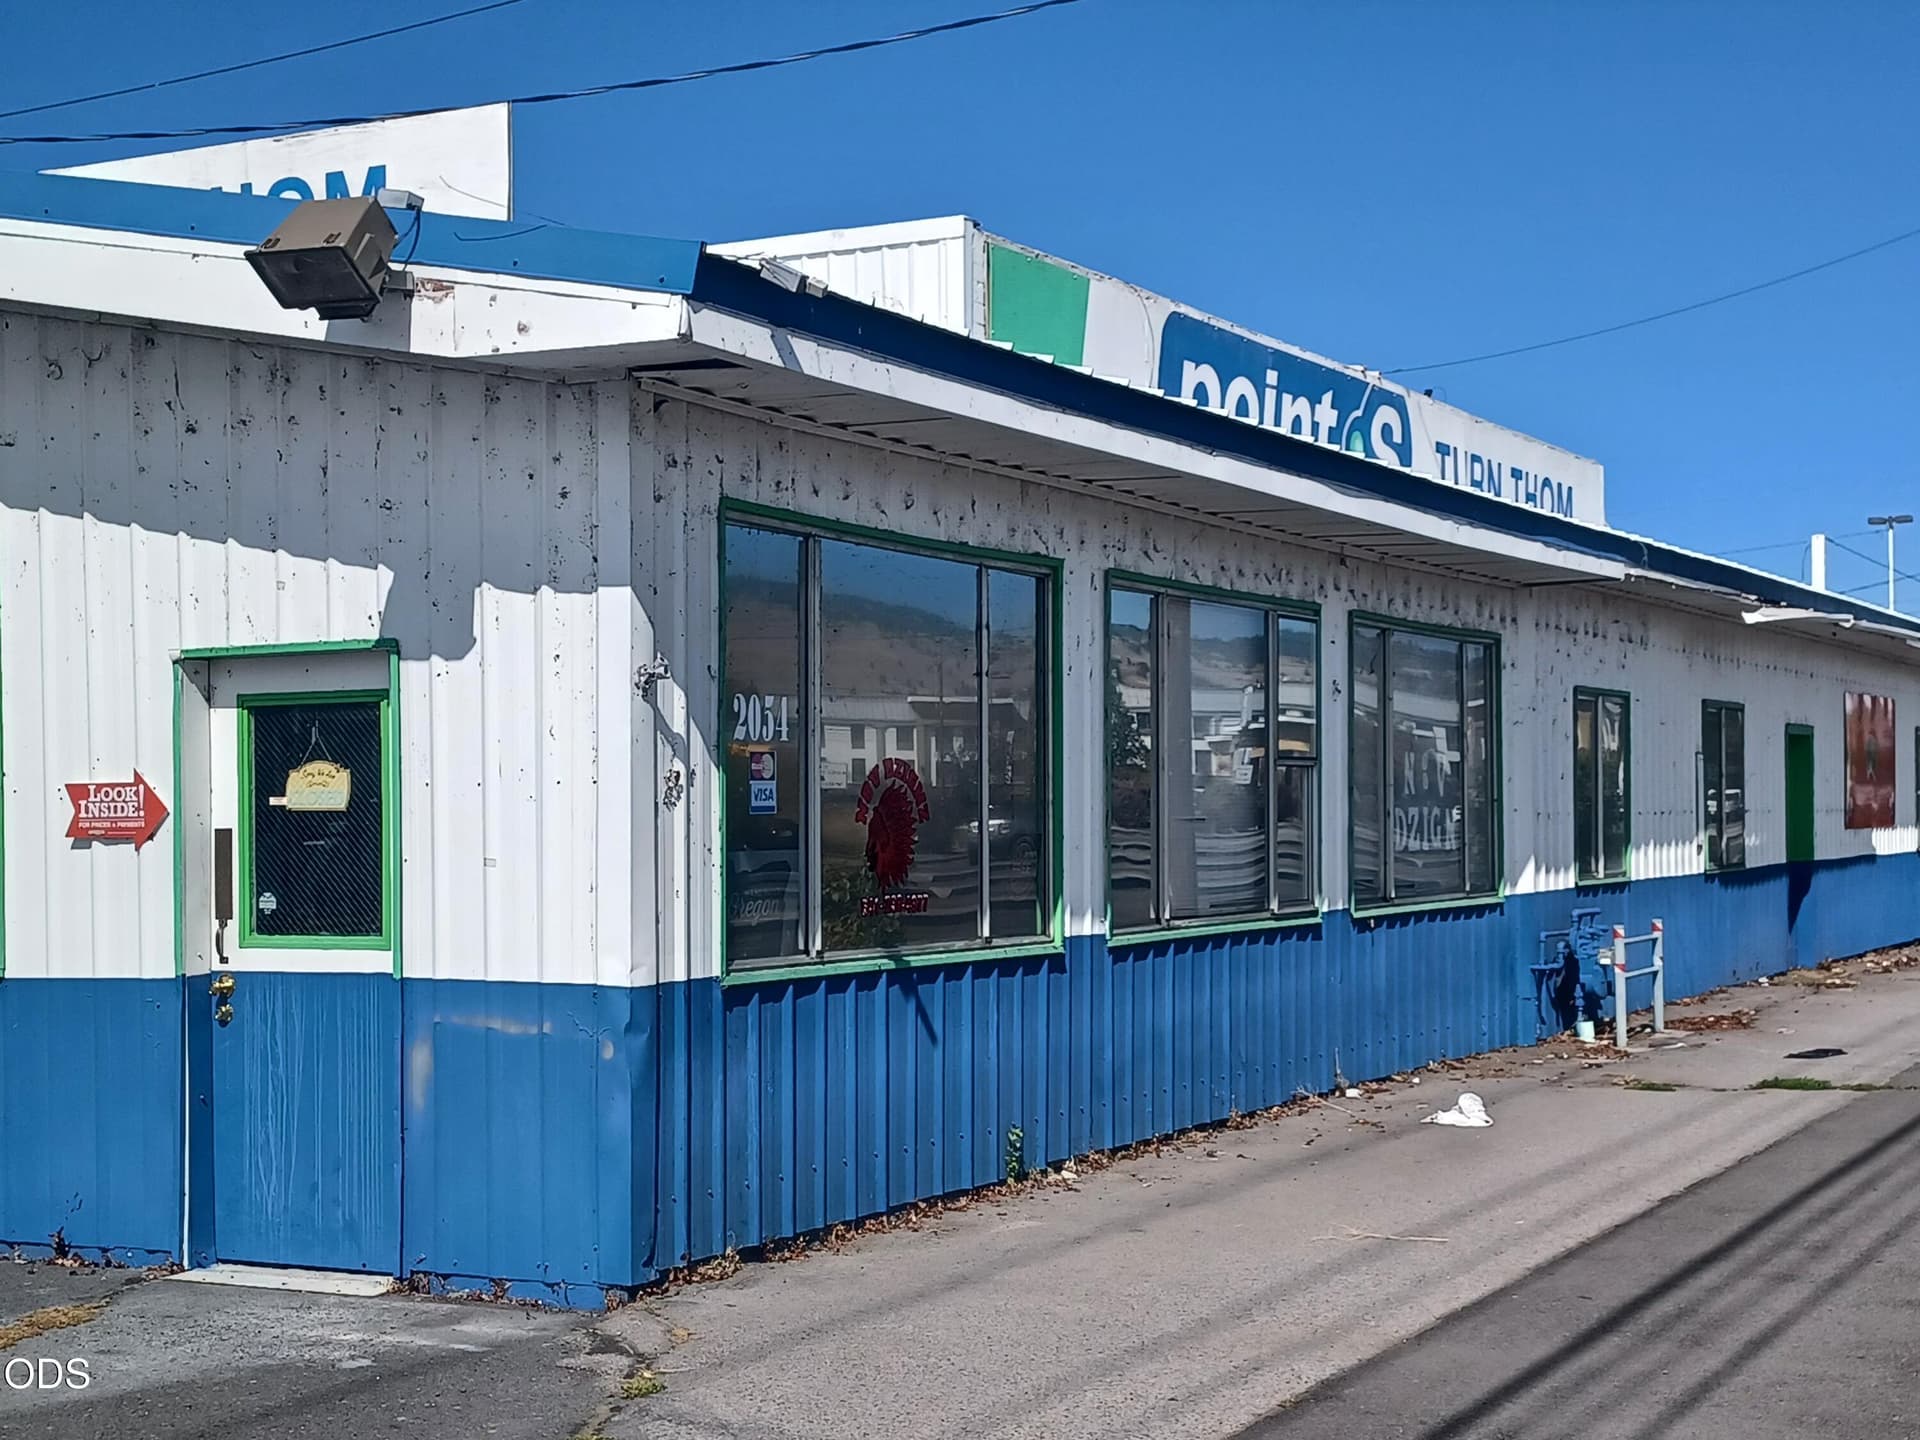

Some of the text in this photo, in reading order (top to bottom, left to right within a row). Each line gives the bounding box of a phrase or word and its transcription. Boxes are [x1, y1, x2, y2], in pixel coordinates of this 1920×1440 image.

[1435, 440, 1574, 519] TURN THOM
[733, 693, 790, 742] 2054
[88, 785, 138, 802] LOOK
[753, 788, 775, 802] VISA
